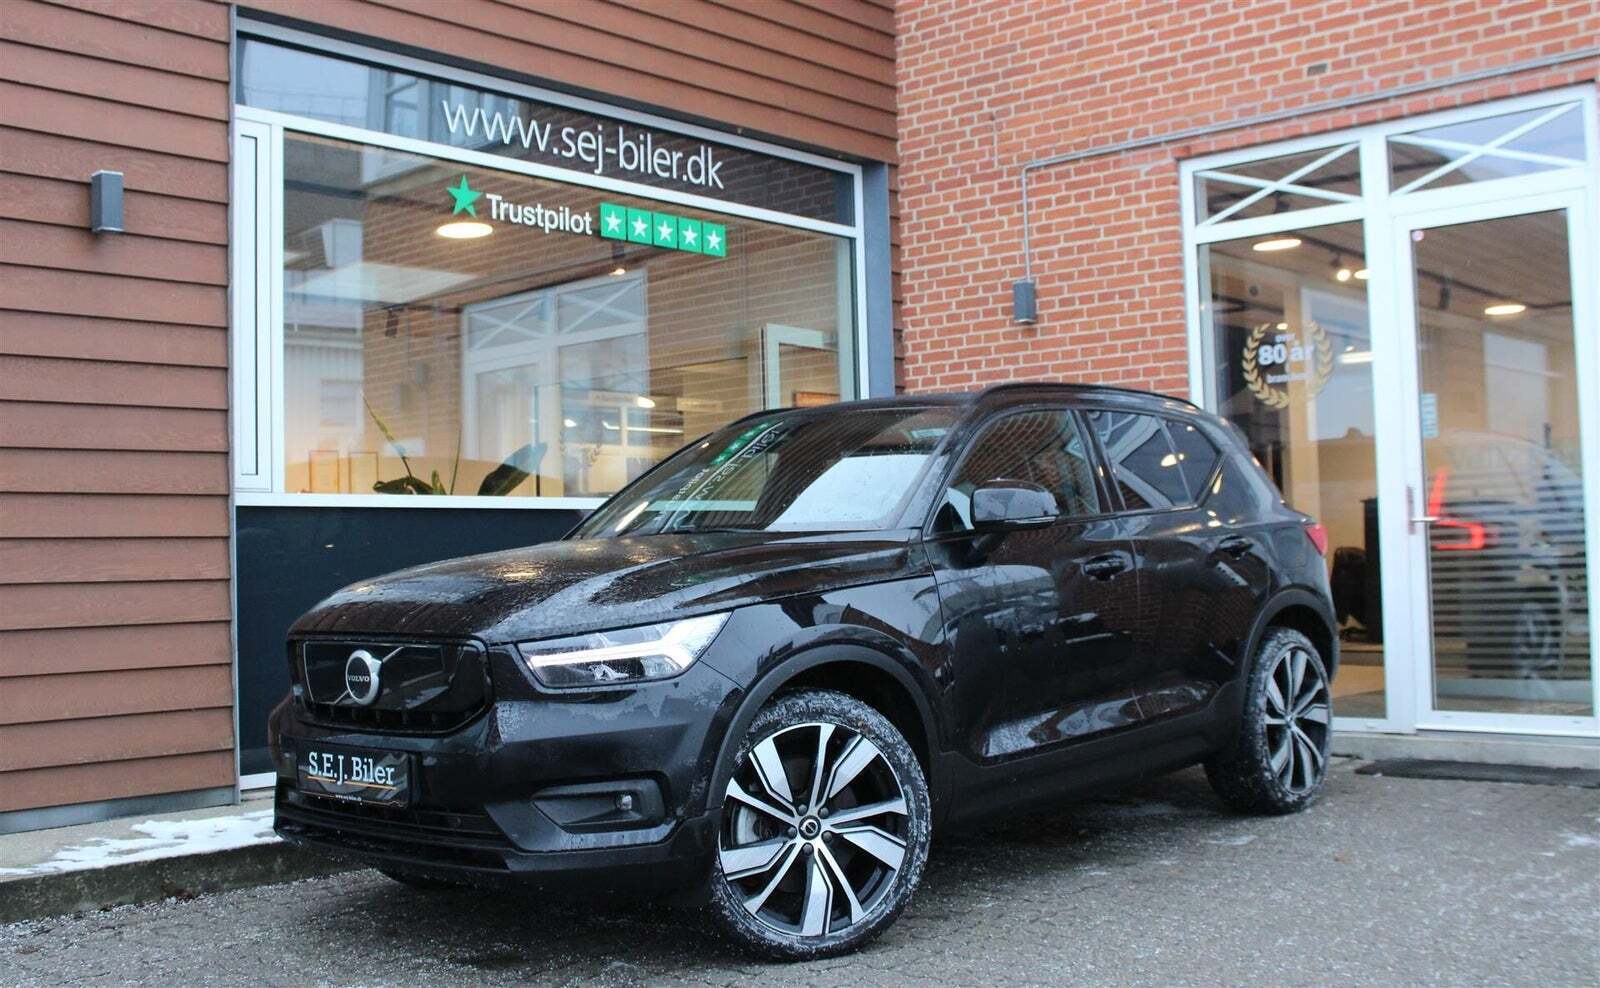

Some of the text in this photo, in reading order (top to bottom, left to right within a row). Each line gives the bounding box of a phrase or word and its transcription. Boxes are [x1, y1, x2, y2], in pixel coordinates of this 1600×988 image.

[442, 99, 725, 190] www.sej-biler.dk
[486, 193, 593, 235] Trustpilot
[1258, 344, 1287, 366] 80
[348, 674, 370, 682] VOLVO
[308, 751, 395, 786] S.E.J. Biler
